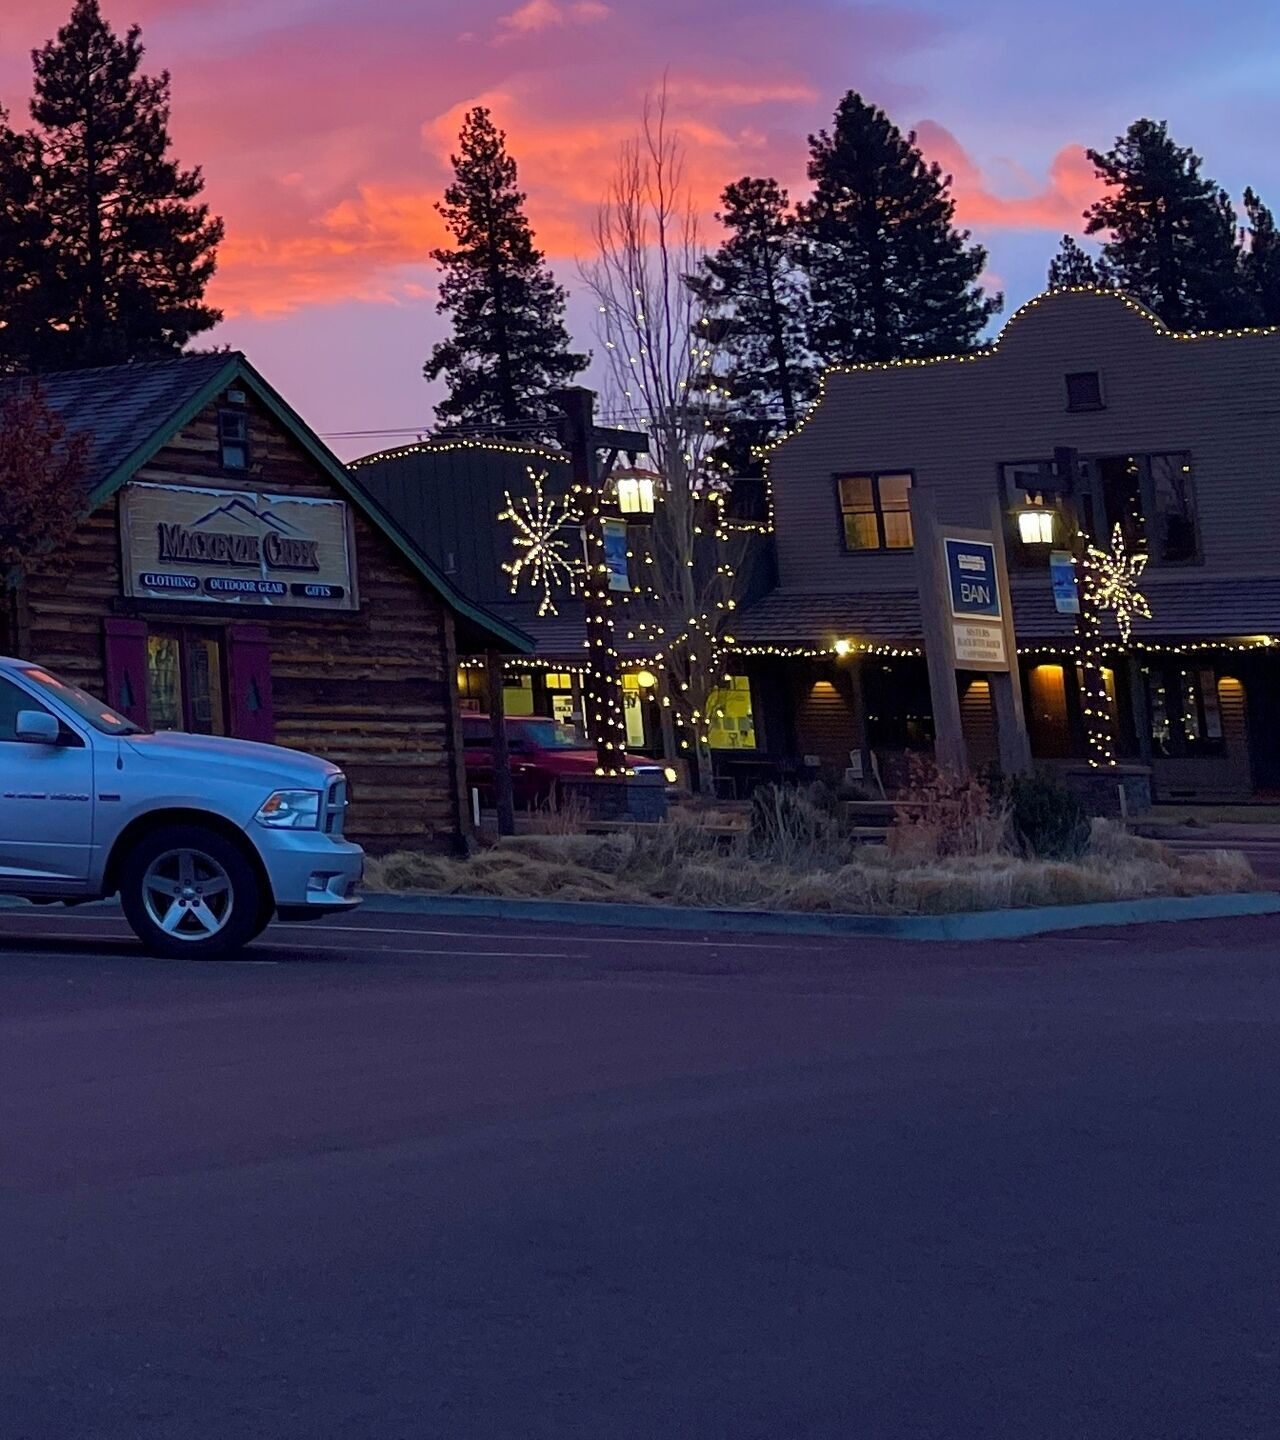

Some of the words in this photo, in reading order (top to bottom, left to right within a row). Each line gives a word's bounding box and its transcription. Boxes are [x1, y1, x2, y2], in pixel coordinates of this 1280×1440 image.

[144, 574, 197, 589] CLOTHING
[210, 579, 257, 593] OUTDOOR
[258, 582, 284, 594] GEAR
[304, 584, 331, 597] GIFTS
